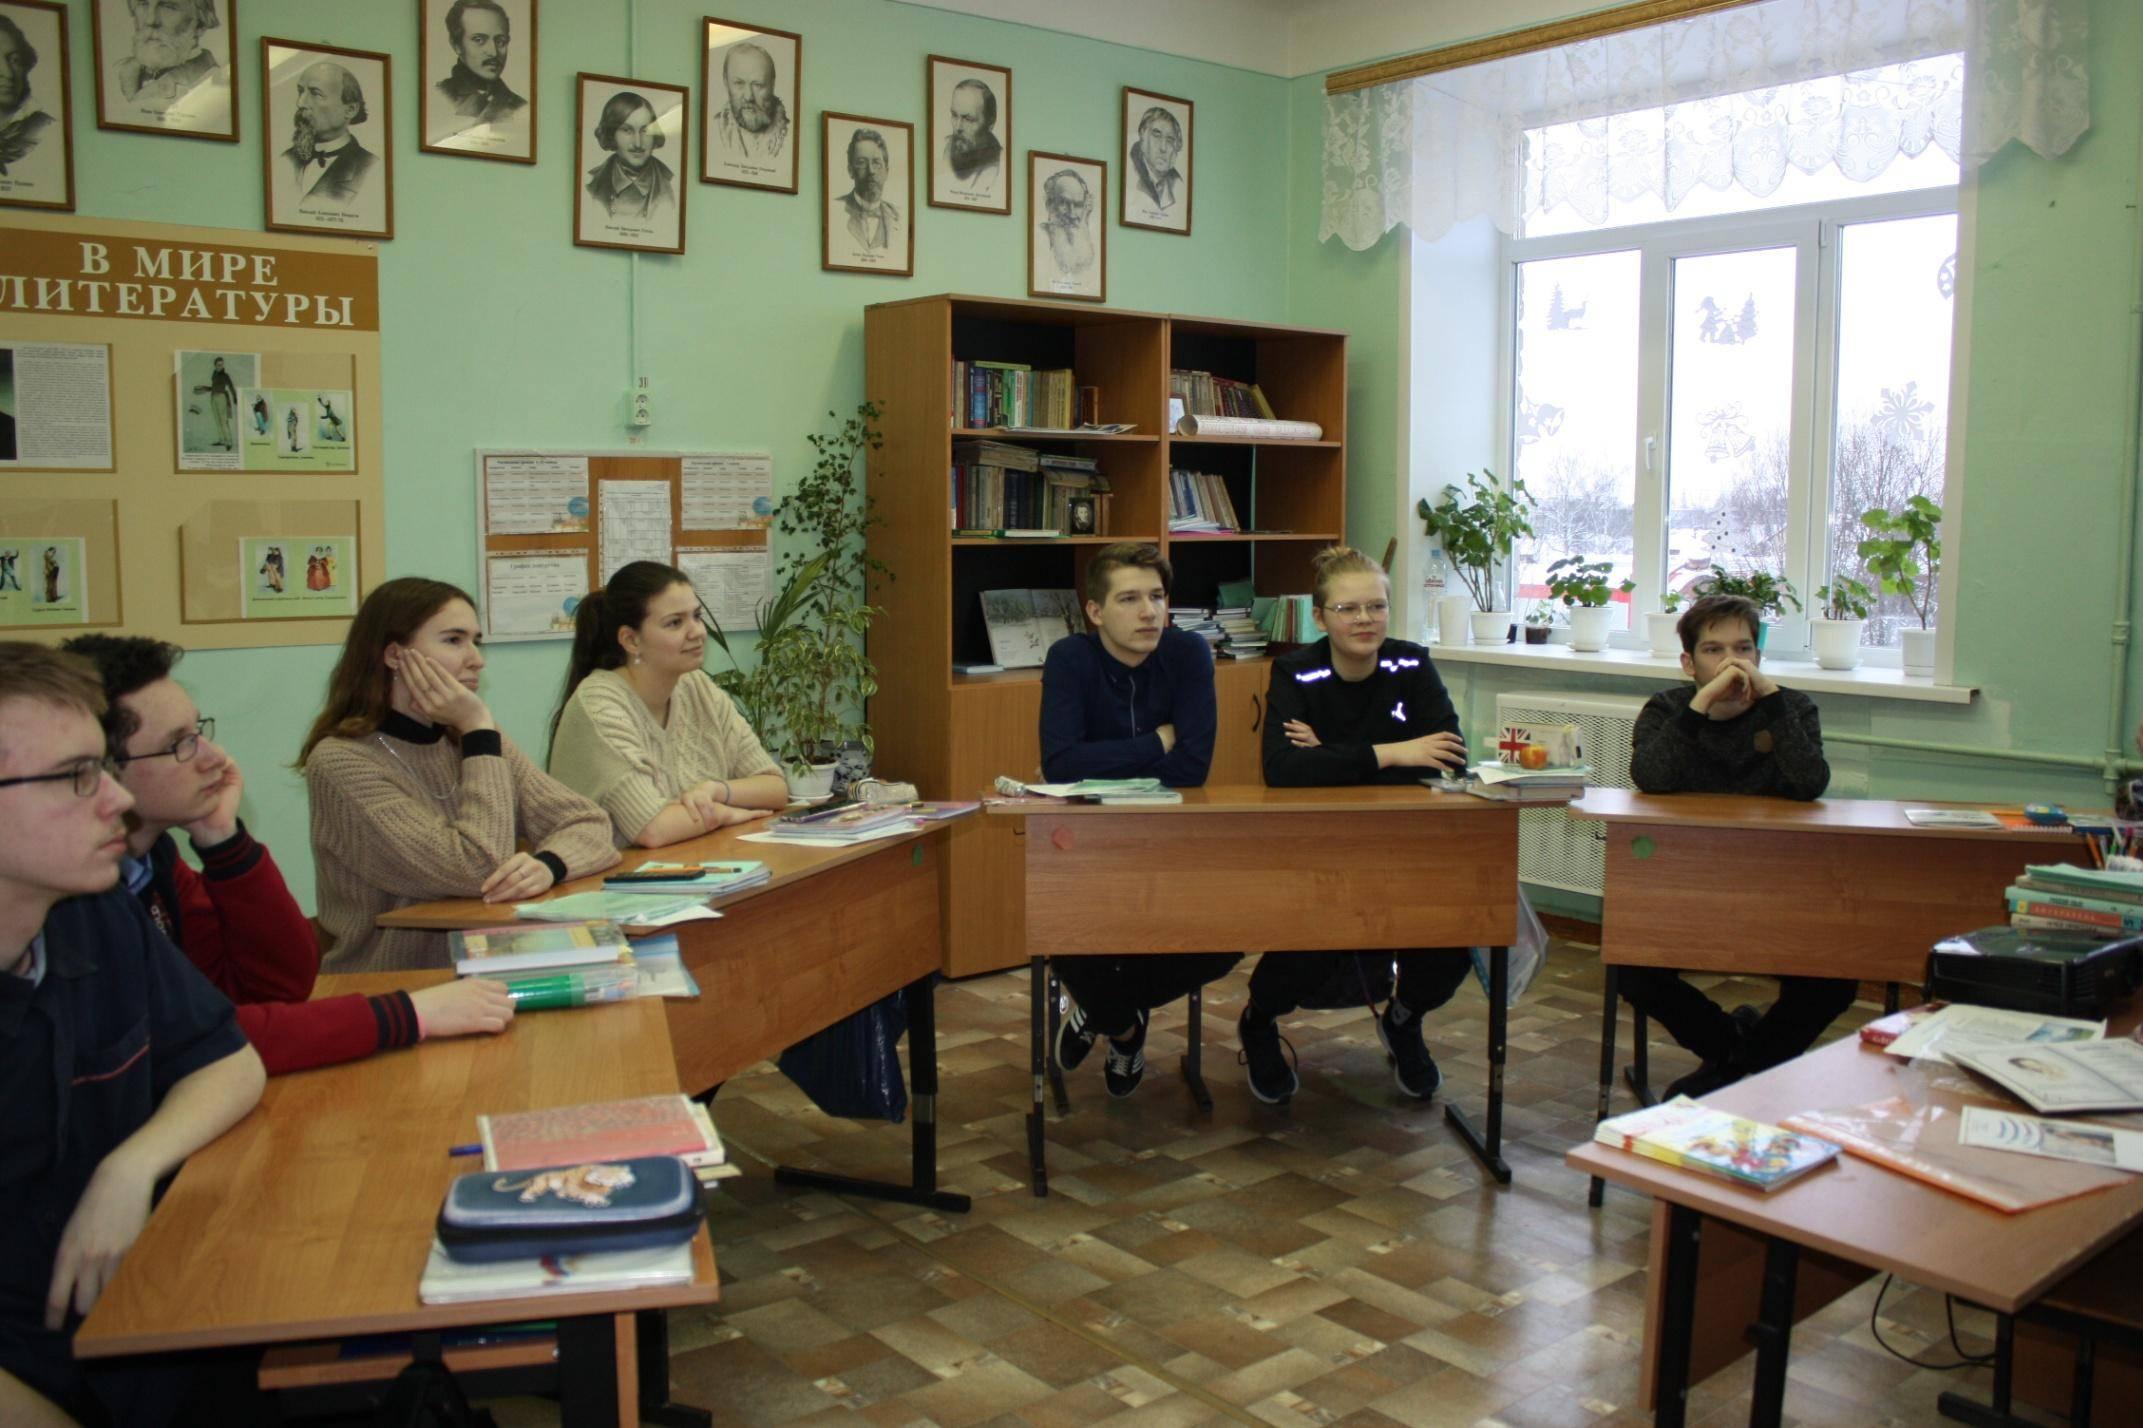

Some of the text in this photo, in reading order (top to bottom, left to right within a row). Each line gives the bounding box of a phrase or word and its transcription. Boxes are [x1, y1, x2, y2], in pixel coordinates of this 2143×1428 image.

[79, 241, 278, 286] В МИРЕ
[0, 275, 356, 327] ЛИТЕРАТУРЫ
